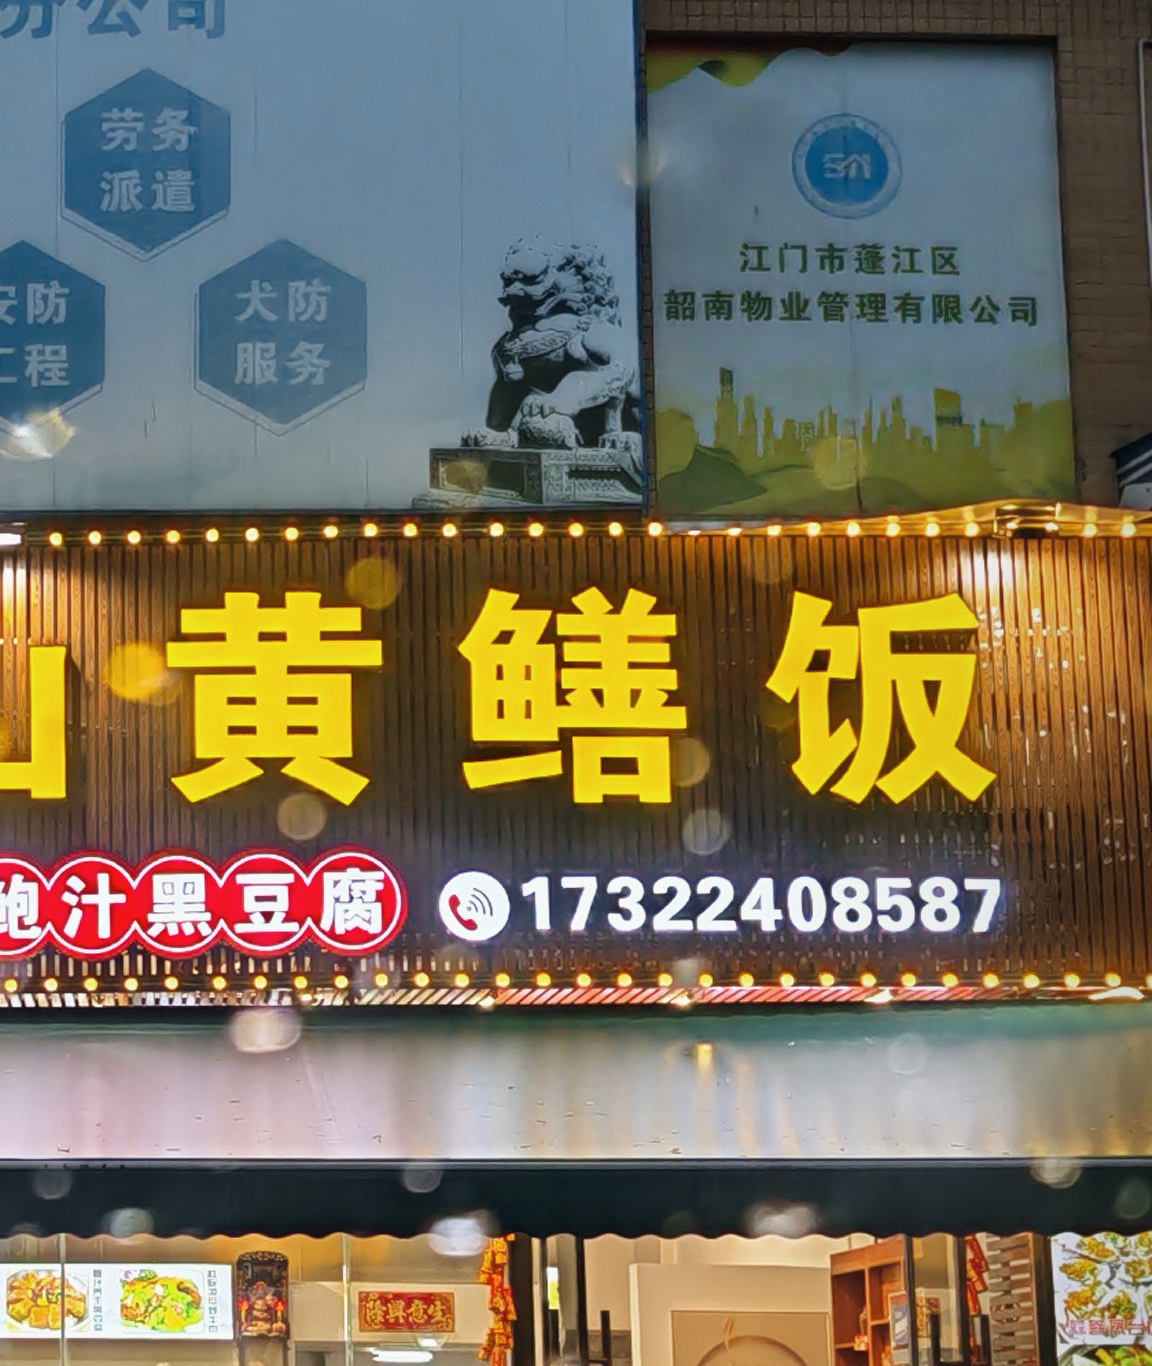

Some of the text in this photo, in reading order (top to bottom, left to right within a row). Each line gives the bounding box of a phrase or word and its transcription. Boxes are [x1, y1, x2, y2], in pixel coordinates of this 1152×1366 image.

[100, 107, 198, 153] 劳务
[99, 169, 197, 213] 派遣
[739, 242, 960, 276] 江门市蓬江区
[235, 279, 331, 323] 犬防
[664, 289, 1039, 327] 韶南物业管理有限公司
[234, 341, 332, 386] 服务
[520, 875, 1003, 933] 17322408587
